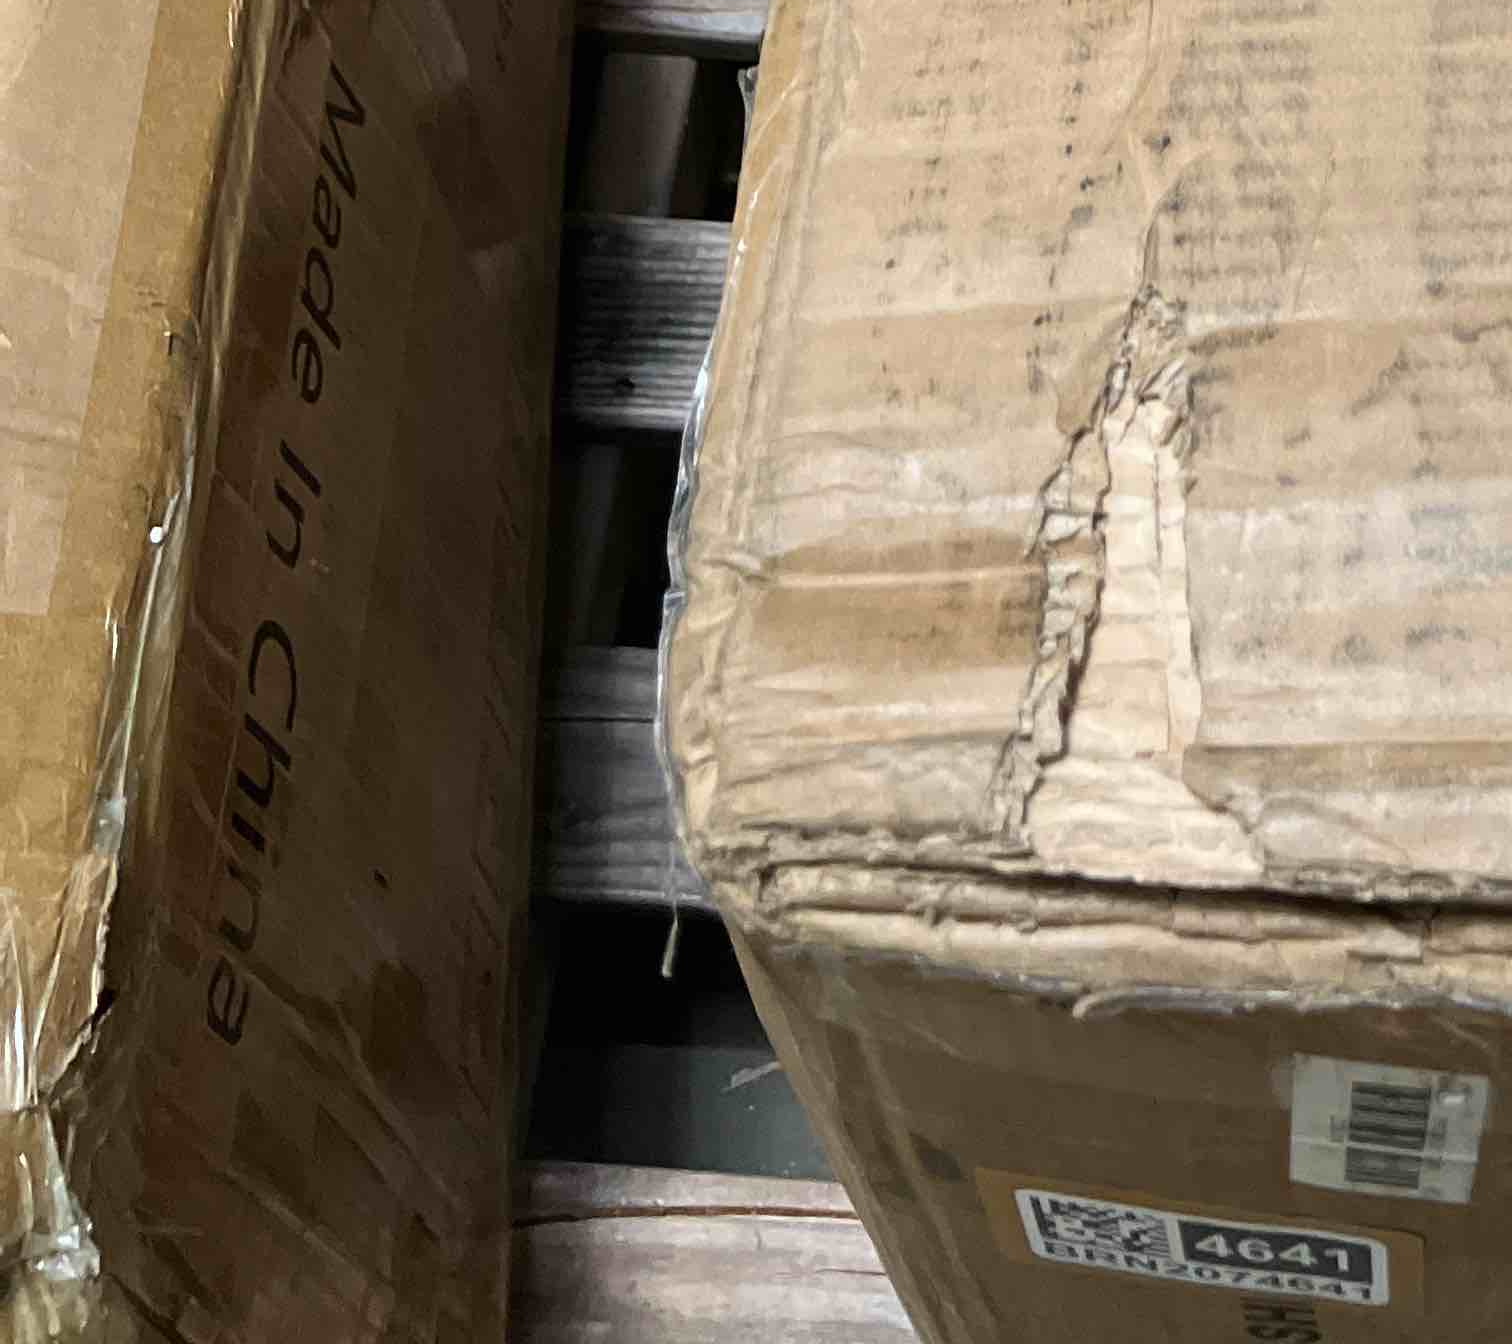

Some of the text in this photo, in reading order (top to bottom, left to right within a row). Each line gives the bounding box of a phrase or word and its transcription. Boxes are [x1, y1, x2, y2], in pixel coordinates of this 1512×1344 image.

[205, 58, 368, 1049] Made In China
[1044, 1240, 1373, 1301] BRN2074641
[1194, 1231, 1351, 1275] 4641
